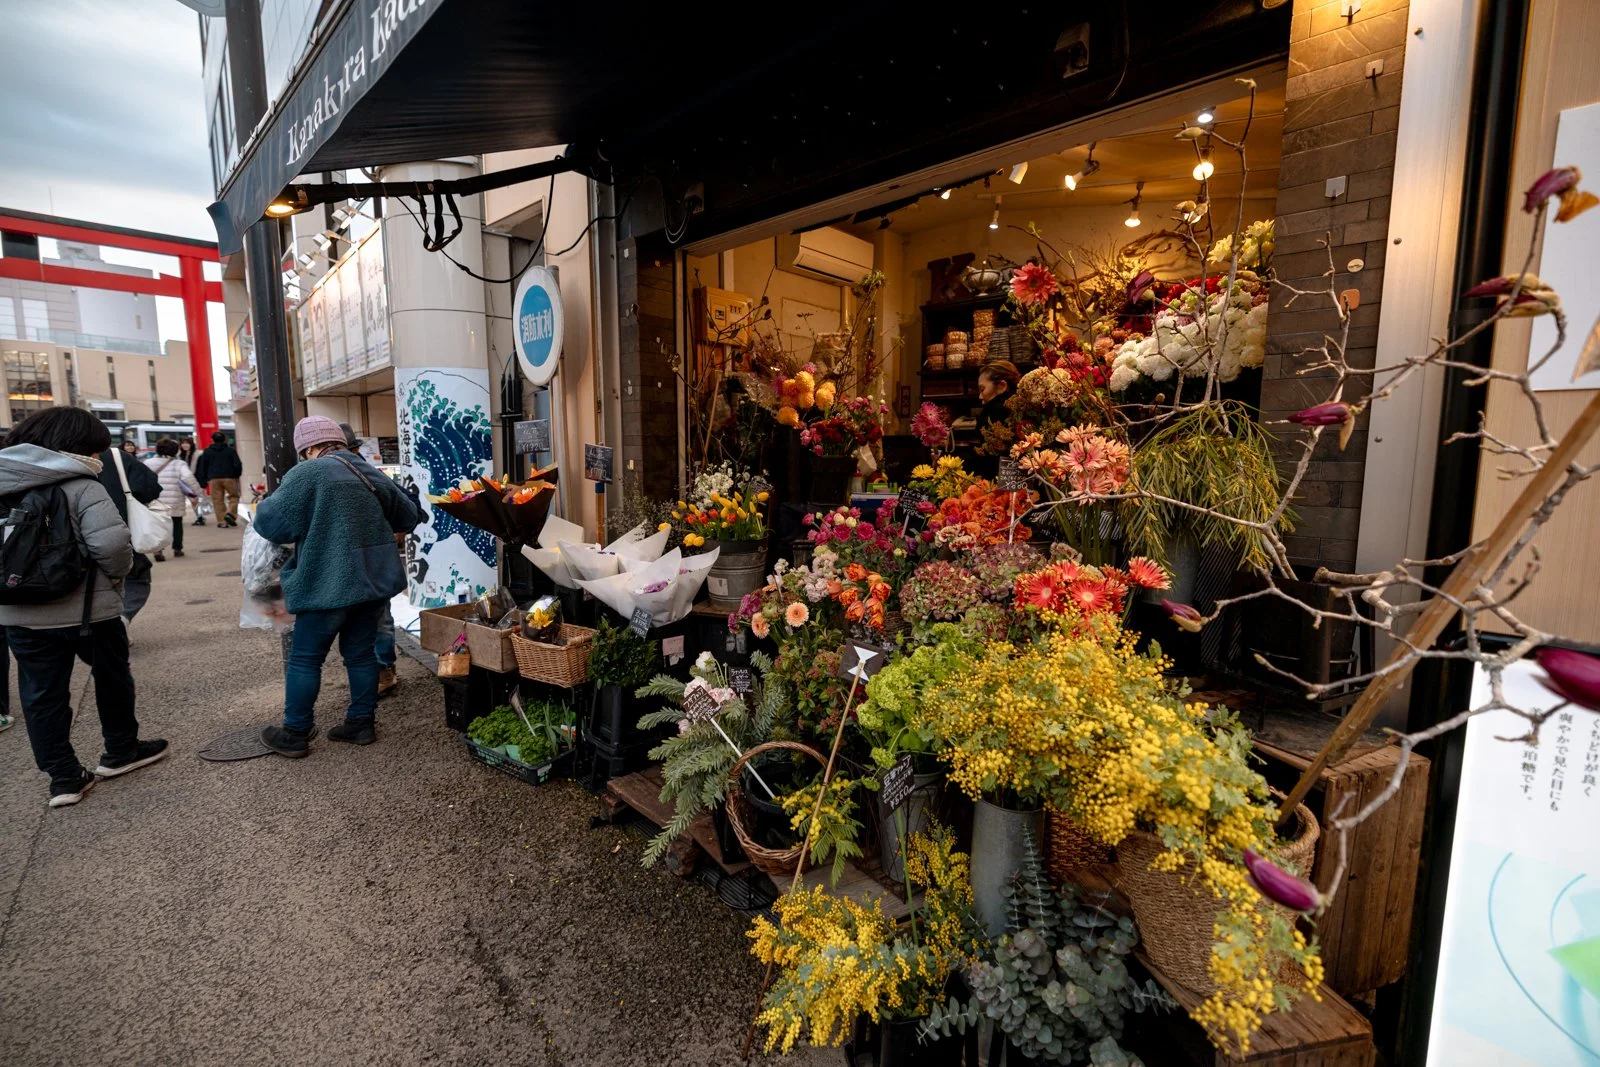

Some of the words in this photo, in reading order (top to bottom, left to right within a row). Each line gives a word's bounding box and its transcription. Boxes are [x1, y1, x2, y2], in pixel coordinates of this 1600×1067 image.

[521, 307, 552, 344] 消防水利
[400, 408, 412, 467] 北海道
[890, 785, 909, 810] ¥550
